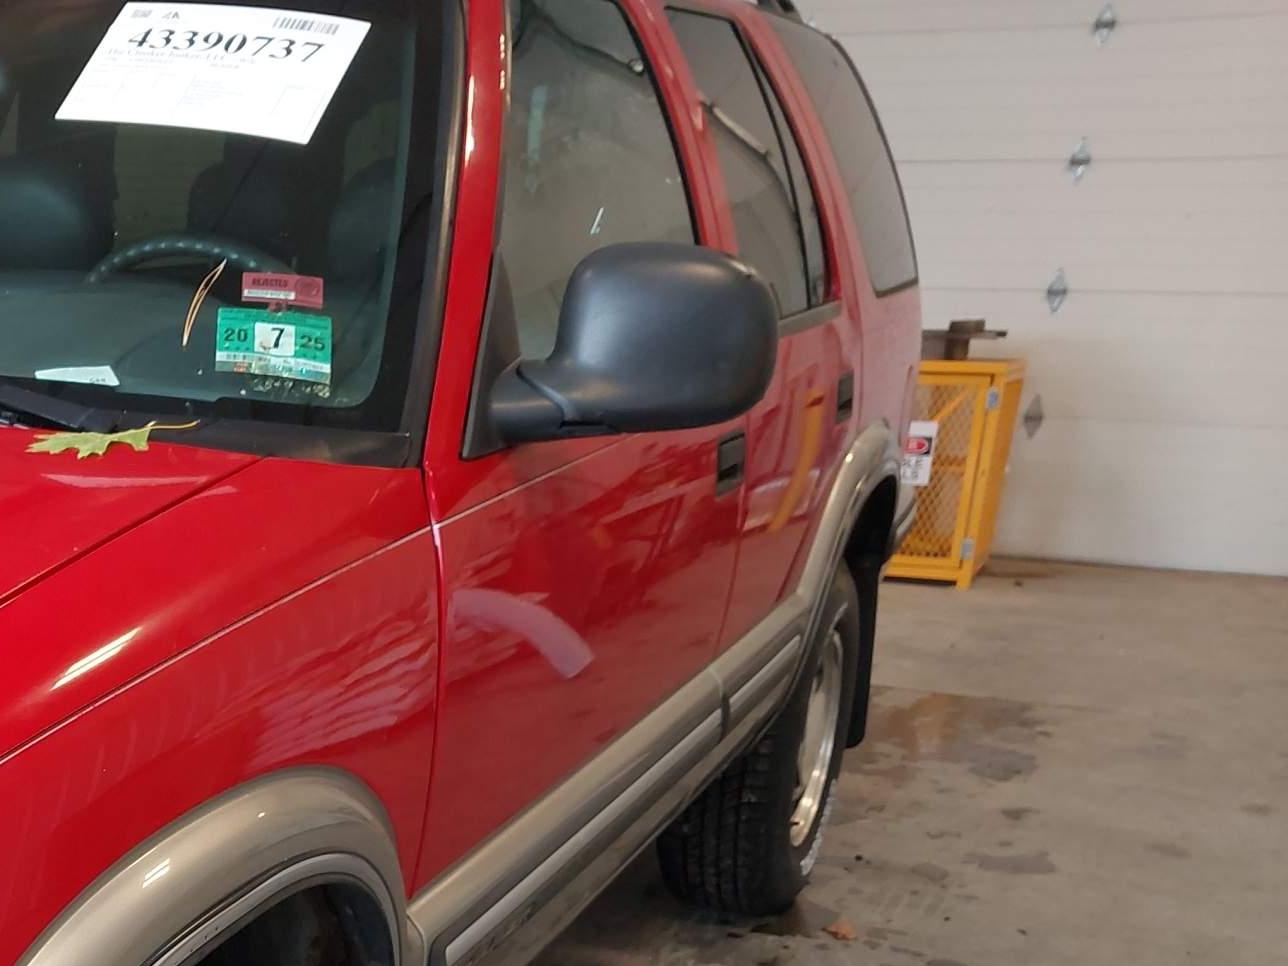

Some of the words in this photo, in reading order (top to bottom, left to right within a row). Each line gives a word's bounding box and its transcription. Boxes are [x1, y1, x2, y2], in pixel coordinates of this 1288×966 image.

[127, 28, 326, 63] 43390737
[223, 328, 248, 343] 20
[271, 328, 285, 349] 7
[300, 335, 325, 351] 25
